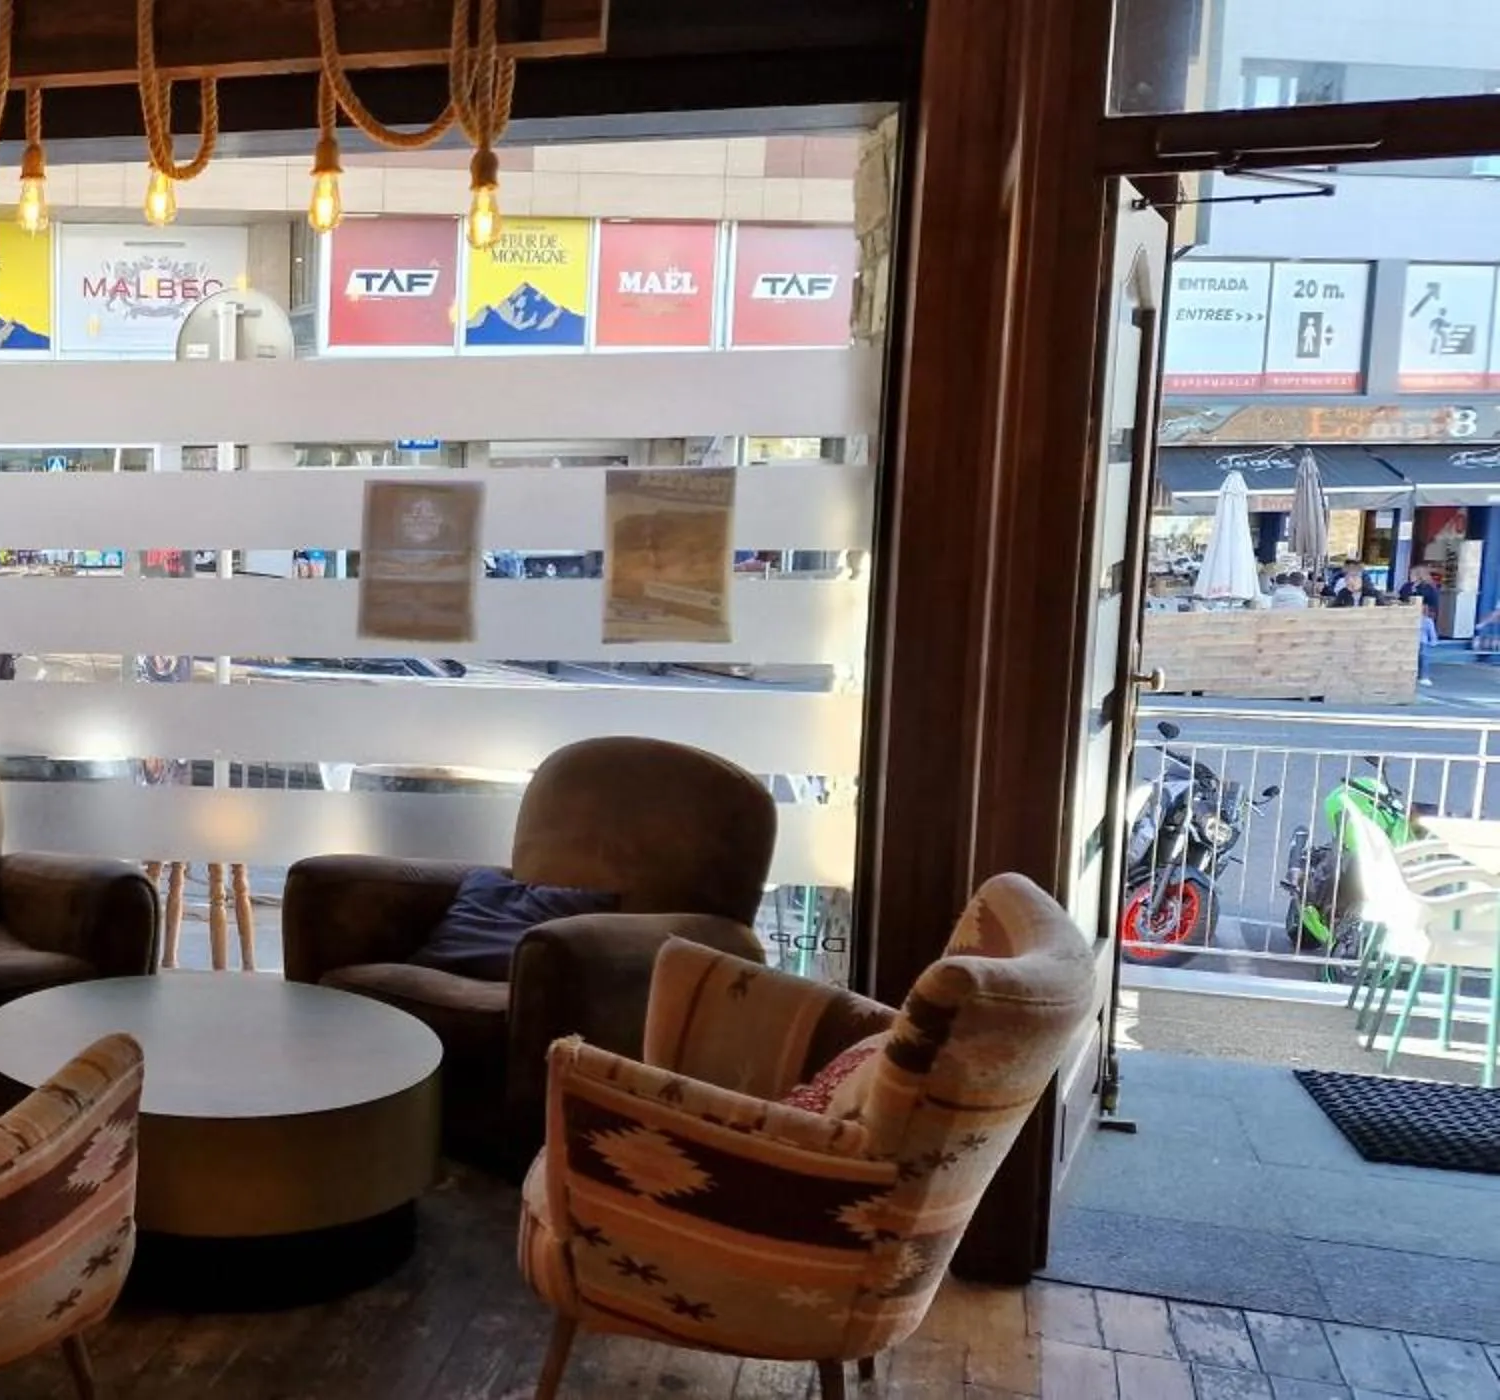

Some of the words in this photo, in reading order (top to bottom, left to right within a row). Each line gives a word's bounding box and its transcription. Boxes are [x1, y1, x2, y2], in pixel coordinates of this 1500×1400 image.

[355, 267, 434, 293] TAF
[617, 265, 699, 295] MAËL
[761, 273, 833, 297] TAF
[1177, 278, 1249, 291] ENTRADA
[1292, 279, 1318, 299] 20
[1322, 283, 1346, 300] m.
